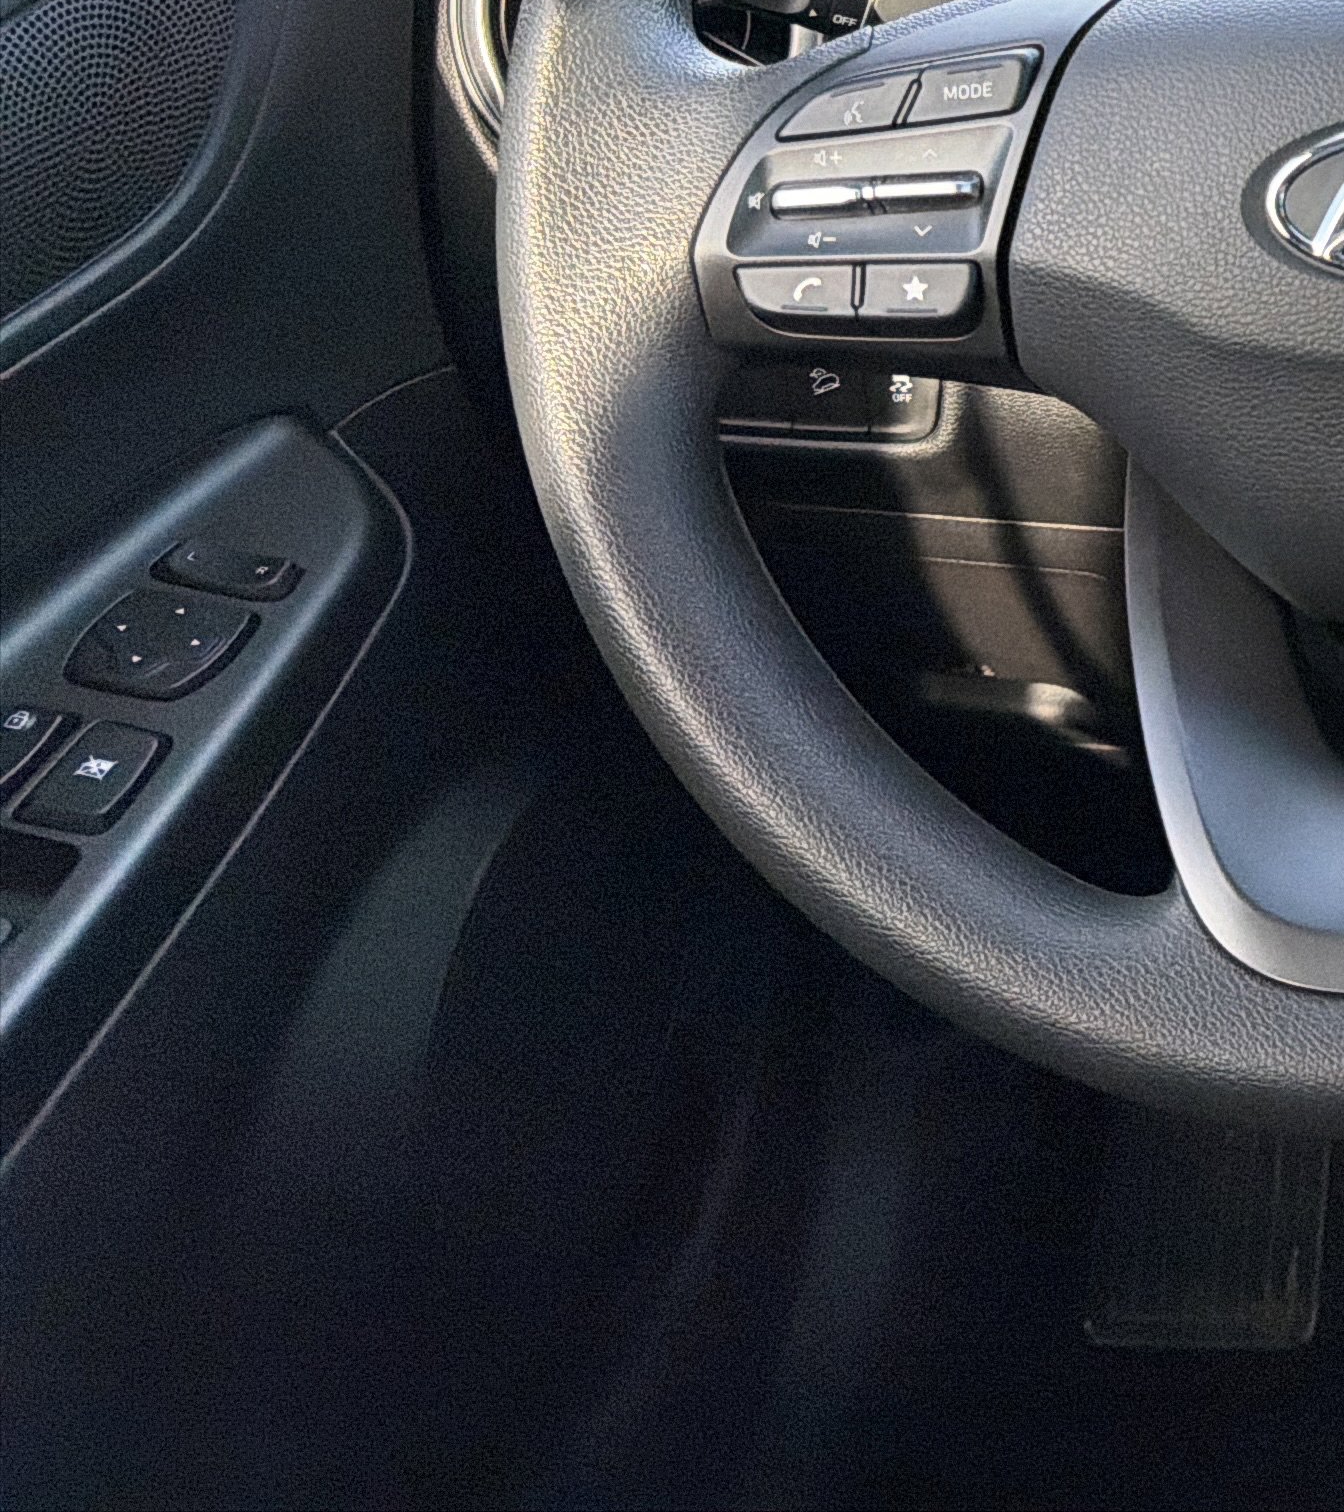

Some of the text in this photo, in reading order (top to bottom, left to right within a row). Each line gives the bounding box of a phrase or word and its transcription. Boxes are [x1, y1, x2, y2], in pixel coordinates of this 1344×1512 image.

[832, 14, 859, 27] OFF
[943, 80, 993, 101] MODE
[891, 392, 913, 403] OFF
